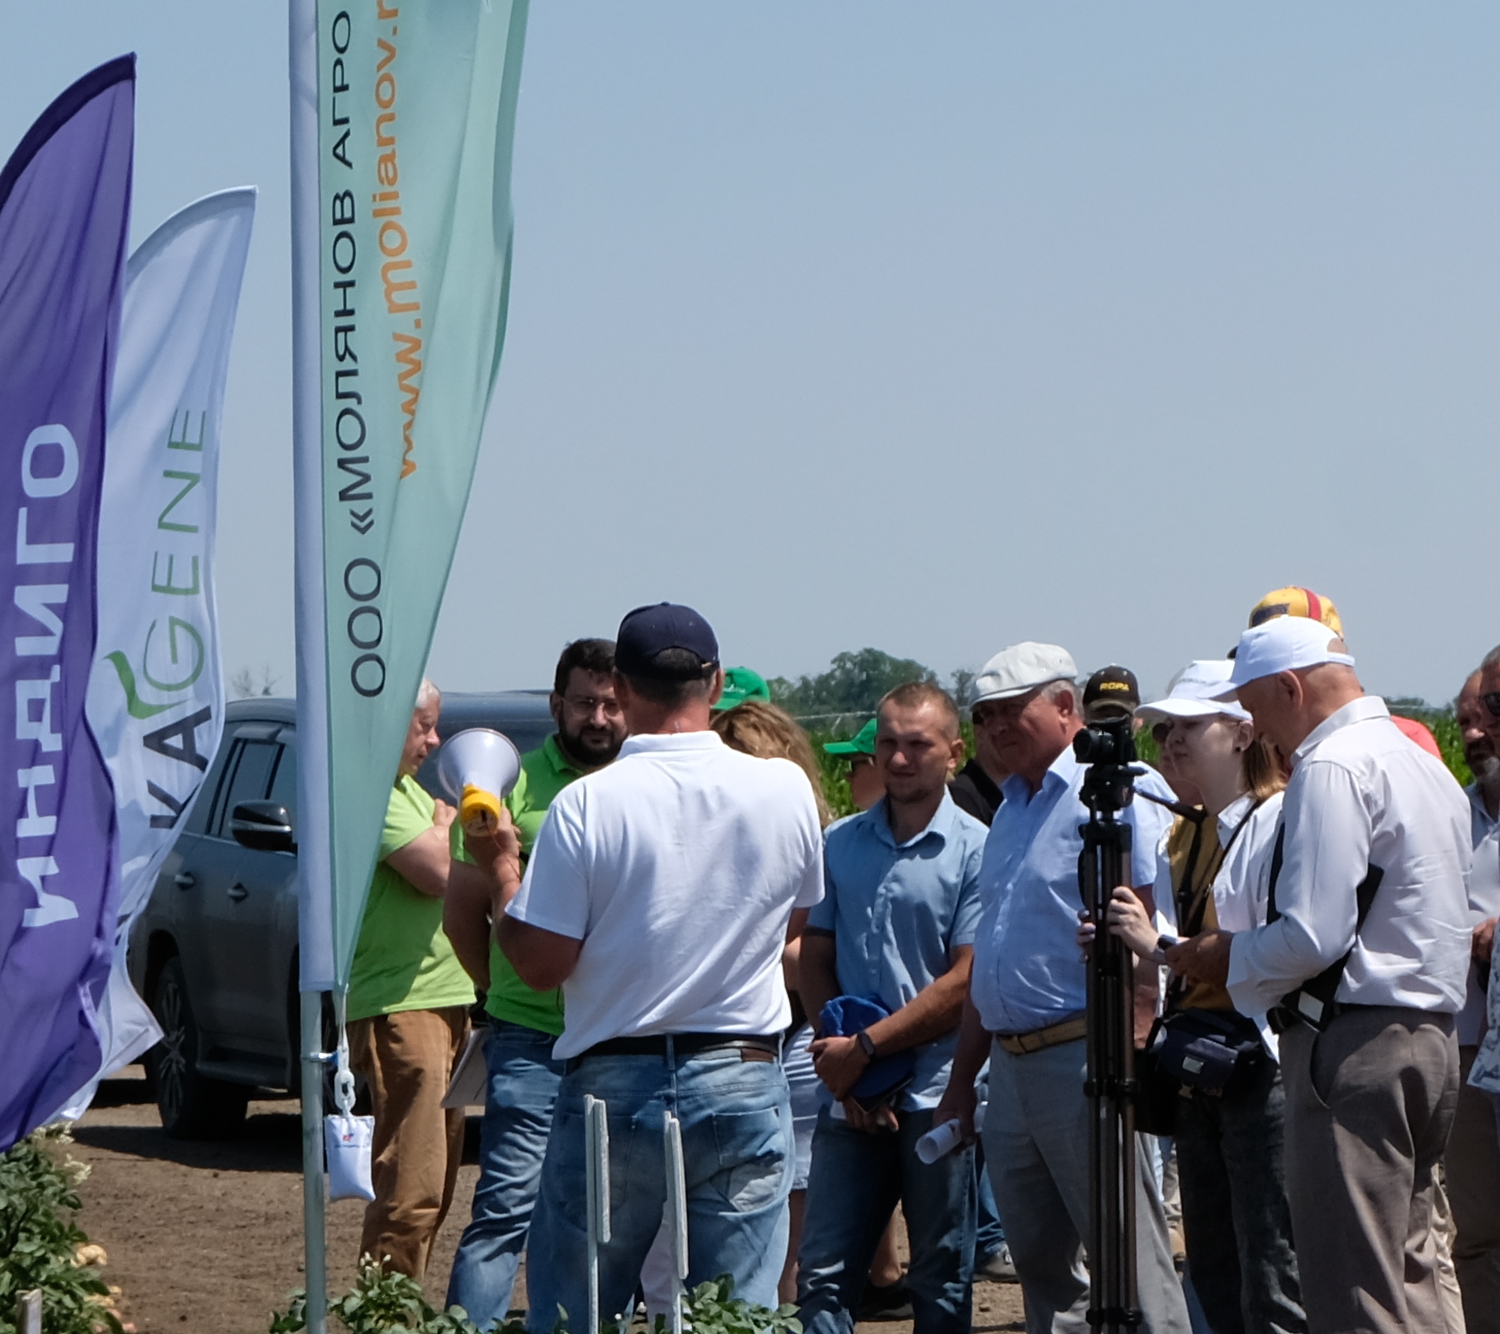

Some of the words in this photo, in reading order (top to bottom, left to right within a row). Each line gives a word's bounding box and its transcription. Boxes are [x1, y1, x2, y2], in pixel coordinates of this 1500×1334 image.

[331, 9, 354, 171] АГРО
[331, 188, 376, 536] «МОЛЯНОВ
[14, 422, 81, 929] ИНДИГО
[136, 407, 212, 832] KAGENE
[343, 558, 387, 698] ООО
